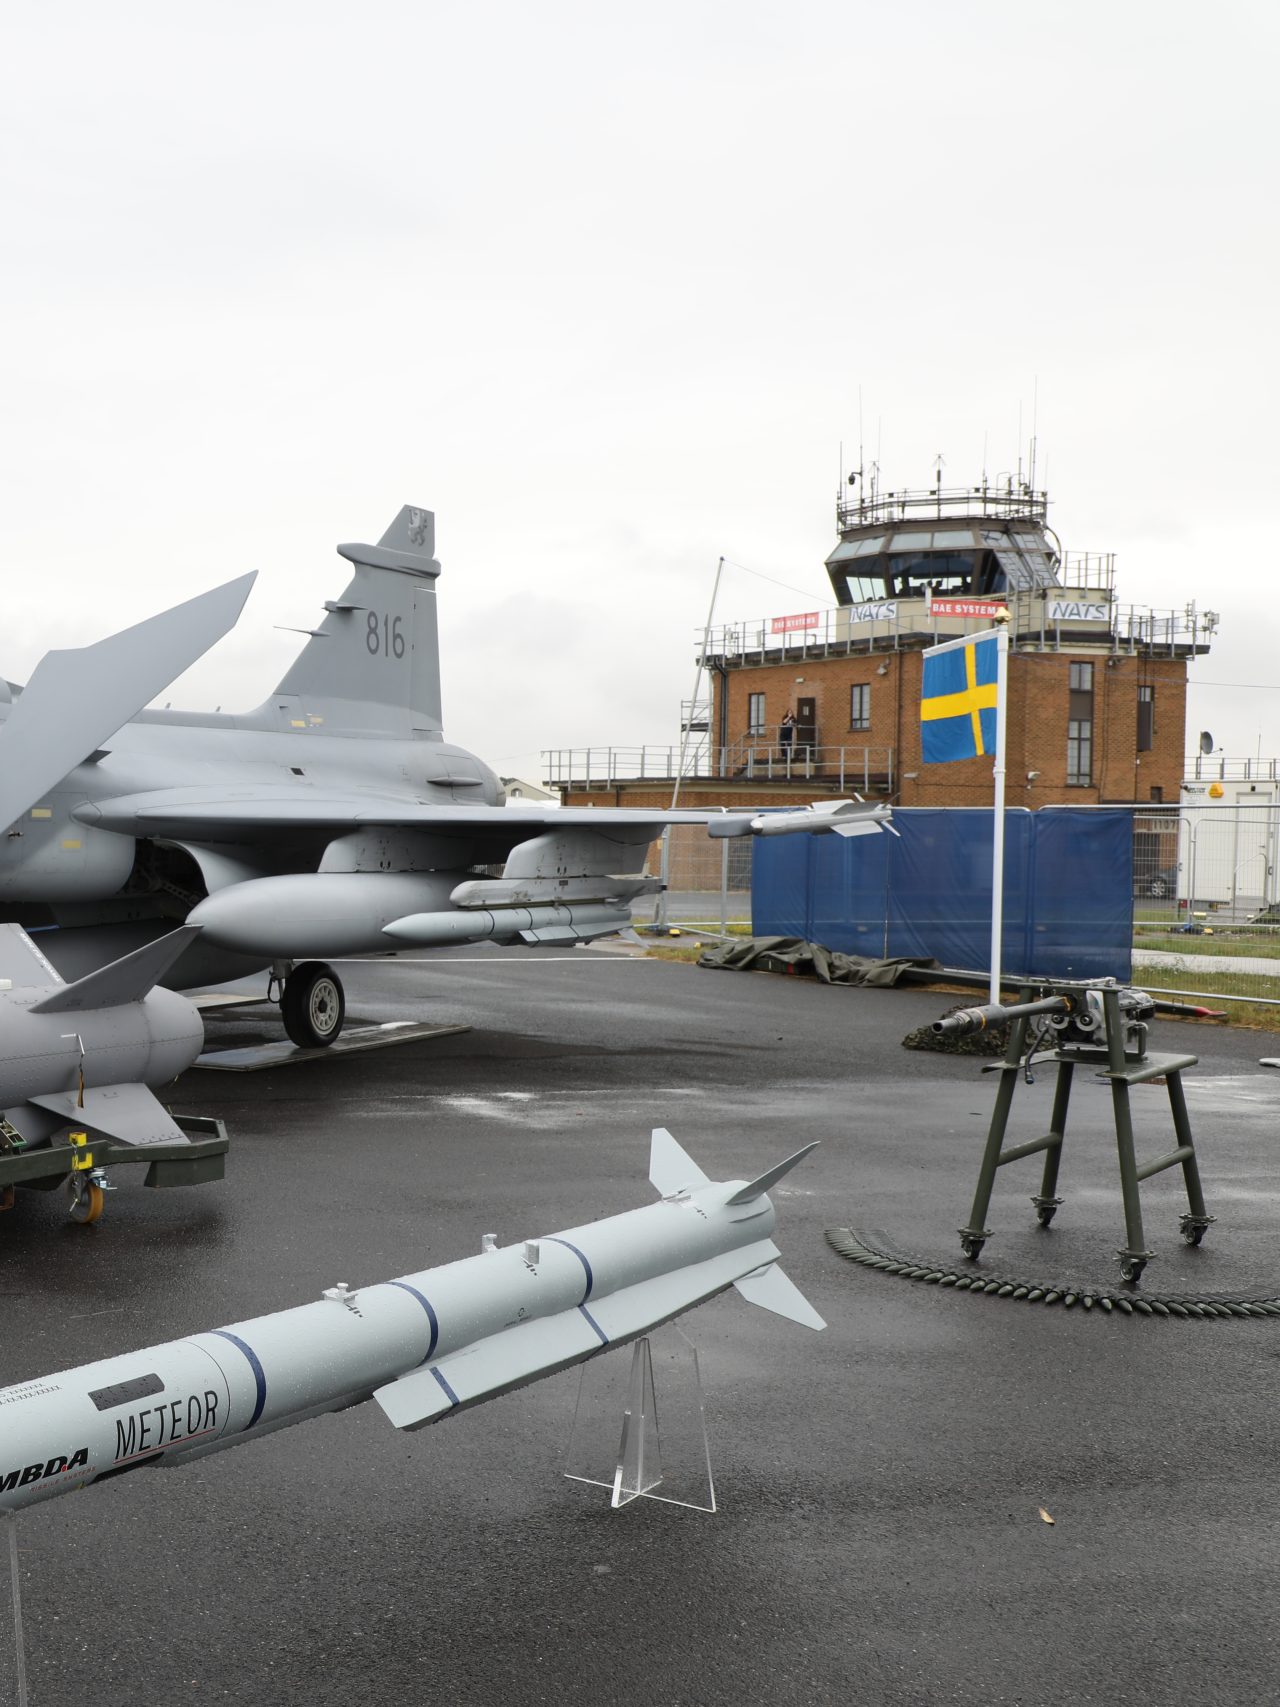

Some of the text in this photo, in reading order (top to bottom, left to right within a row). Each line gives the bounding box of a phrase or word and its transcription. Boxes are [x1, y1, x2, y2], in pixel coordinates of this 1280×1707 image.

[850, 603, 896, 623] NATS
[933, 603, 997, 615] BAE SYSTEM
[1052, 602, 1106, 619] NATS
[366, 611, 405, 659] 816
[115, 1390, 218, 1460] METEOR
